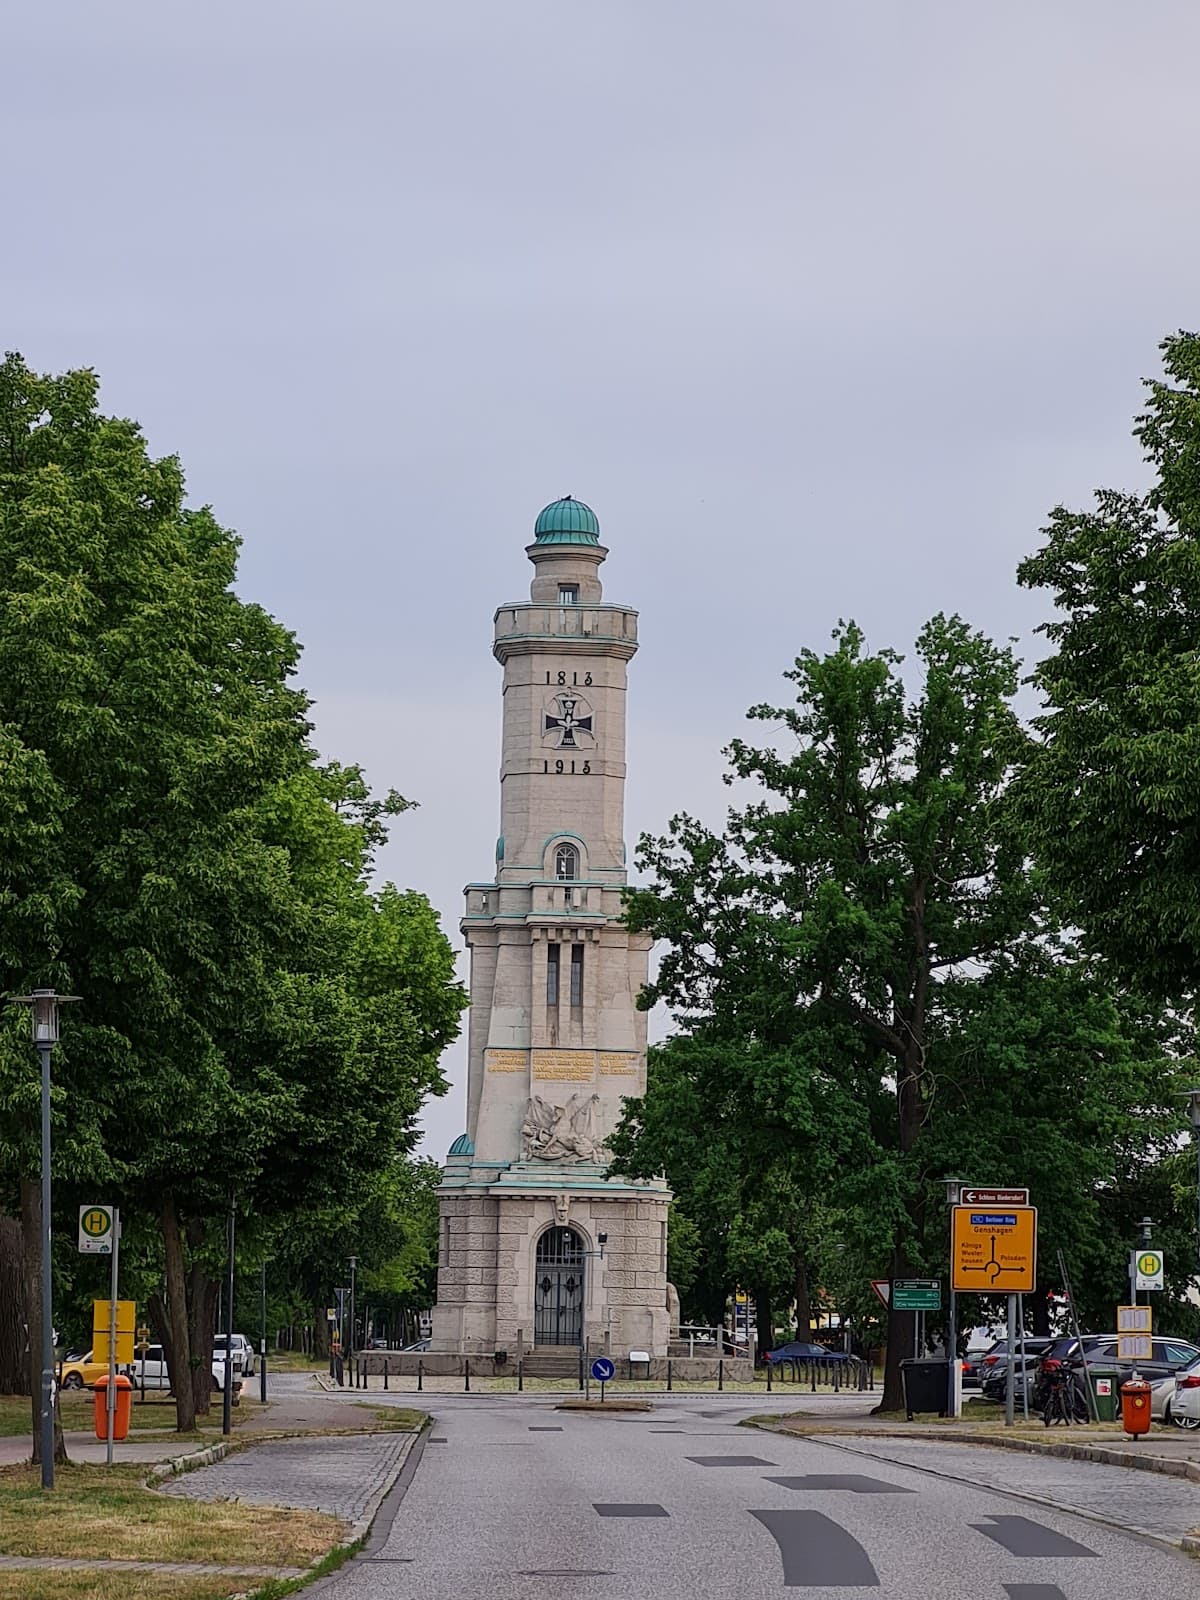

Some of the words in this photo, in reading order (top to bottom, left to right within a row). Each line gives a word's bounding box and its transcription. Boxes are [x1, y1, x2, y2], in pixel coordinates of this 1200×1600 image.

[546, 670, 593, 686] 1813
[543, 759, 591, 775] 1913
[90, 1213, 102, 1230] H
[973, 1226, 1013, 1235] Genshagen
[1144, 1257, 1154, 1272] H
